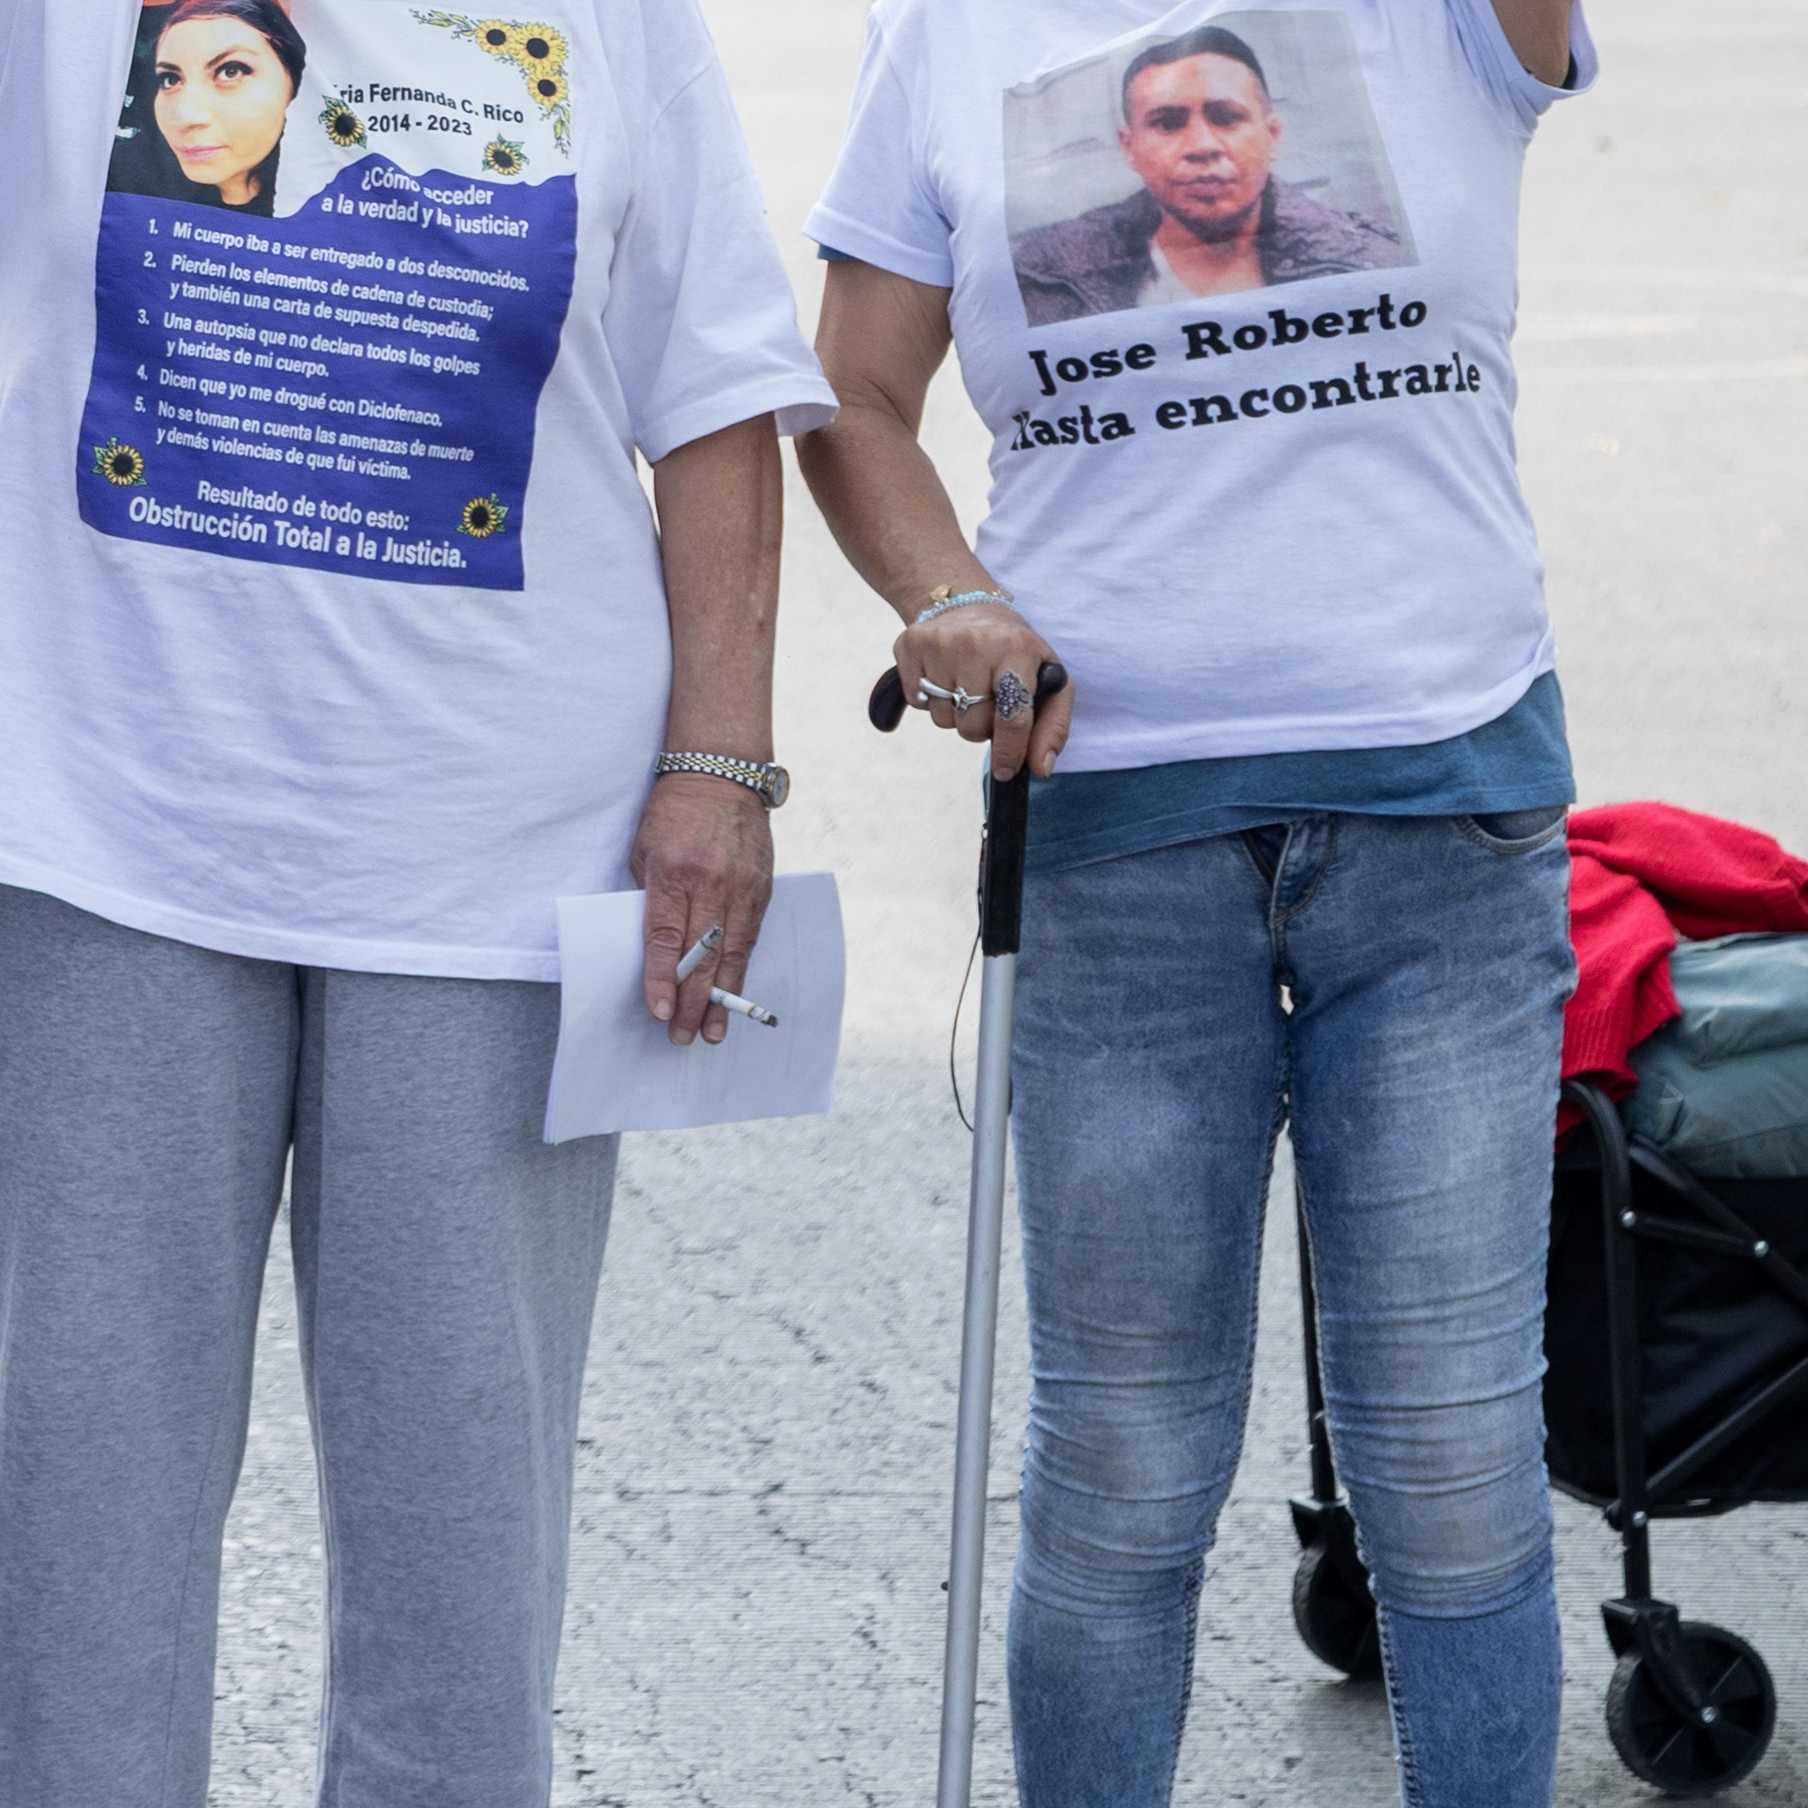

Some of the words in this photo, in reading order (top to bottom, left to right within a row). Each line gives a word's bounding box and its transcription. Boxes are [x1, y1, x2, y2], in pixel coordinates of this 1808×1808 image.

[368, 113, 410, 133] 2014
[427, 114, 473, 136] 2023
[369, 83, 458, 109] Fernanda
[461, 100, 479, 118] C.
[484, 103, 525, 124] Rico
[321, 197, 333, 213] a
[337, 193, 353, 215] la
[358, 198, 418, 223] verdad
[422, 208, 435, 228] y
[437, 210, 453, 228] la
[455, 212, 529, 239] justicia?
[360, 165, 421, 192] ¿Cómo
[423, 185, 495, 206] acceder
[143, 250, 157, 268] 2.
[171, 253, 226, 278] Pierden
[229, 261, 252, 282] los
[253, 267, 329, 295] elementos
[330, 278, 350, 297] de
[352, 283, 404, 305] cadena
[406, 289, 426, 309] de
[428, 296, 494, 322] custodia;
[147, 218, 159, 235] 1.
[173, 221, 192, 239] Mi
[194, 227, 244, 250] cuerpo
[246, 233, 269, 253] iba
[272, 242, 281, 255] a
[284, 243, 309, 260] ser
[310, 246, 384, 269] entregado
[386, 258, 395, 271] a
[398, 256, 425, 276] dos
[427, 260, 530, 292] desconocidos.
[137, 308, 150, 326] 3.
[163, 311, 192, 331] Una
[194, 318, 256, 341] autopsia
[258, 329, 288, 347] que
[288, 334, 308, 350] no
[310, 334, 364, 358] declara
[366, 343, 408, 364] todos
[409, 347, 432, 368] los
[433, 354, 481, 377] golpes
[169, 282, 181, 300] y
[182, 281, 240, 305] también
[243, 291, 271, 311] una
[273, 297, 312, 317] carta
[313, 301, 333, 320] de
[334, 305, 400, 329] supuesta
[402, 313, 481, 343] despedida.
[166, 340, 177, 358] y
[178, 337, 232, 363] heridas
[233, 347, 252, 366] de
[254, 350, 273, 369] mi
[275, 356, 330, 379] cuerpo.
[1029, 341, 1157, 396] Jose
[1181, 293, 1428, 362] Roberto
[136, 363, 148, 381] 4.
[159, 367, 197, 391] Dicen
[199, 377, 227, 397] que
[228, 382, 247, 401] yo
[249, 385, 273, 402] me
[274, 386, 328, 411] drogué
[328, 397, 355, 414] con
[357, 398, 444, 428] Diclofenaco.
[1154, 351, 1481, 432] encontrarle
[134, 395, 147, 413] 5.
[157, 399, 176, 418] No
[177, 406, 193, 422] se
[194, 408, 240, 430] toman
[242, 417, 260, 435] en
[262, 420, 313, 441] cuenta
[315, 424, 337, 445] las
[338, 431, 409, 456] amenazas
[410, 438, 426, 457] de
[427, 442, 476, 462] muerte
[155, 427, 167, 445] y
[167, 426, 210, 451] demás
[212, 435, 284, 462] violencias
[285, 446, 305, 465] de
[306, 453, 334, 471] que
[336, 453, 356, 473] fui
[358, 456, 412, 480] víctima.
[128, 496, 268, 544] Obstrucción
[273, 519, 332, 553] Total
[335, 535, 351, 557] a
[356, 531, 377, 561] la
[381, 537, 468, 569] Justicia.
[197, 479, 289, 514] Resultado
[292, 494, 316, 518] de
[320, 500, 363, 524] todo
[366, 508, 411, 532] esto:
